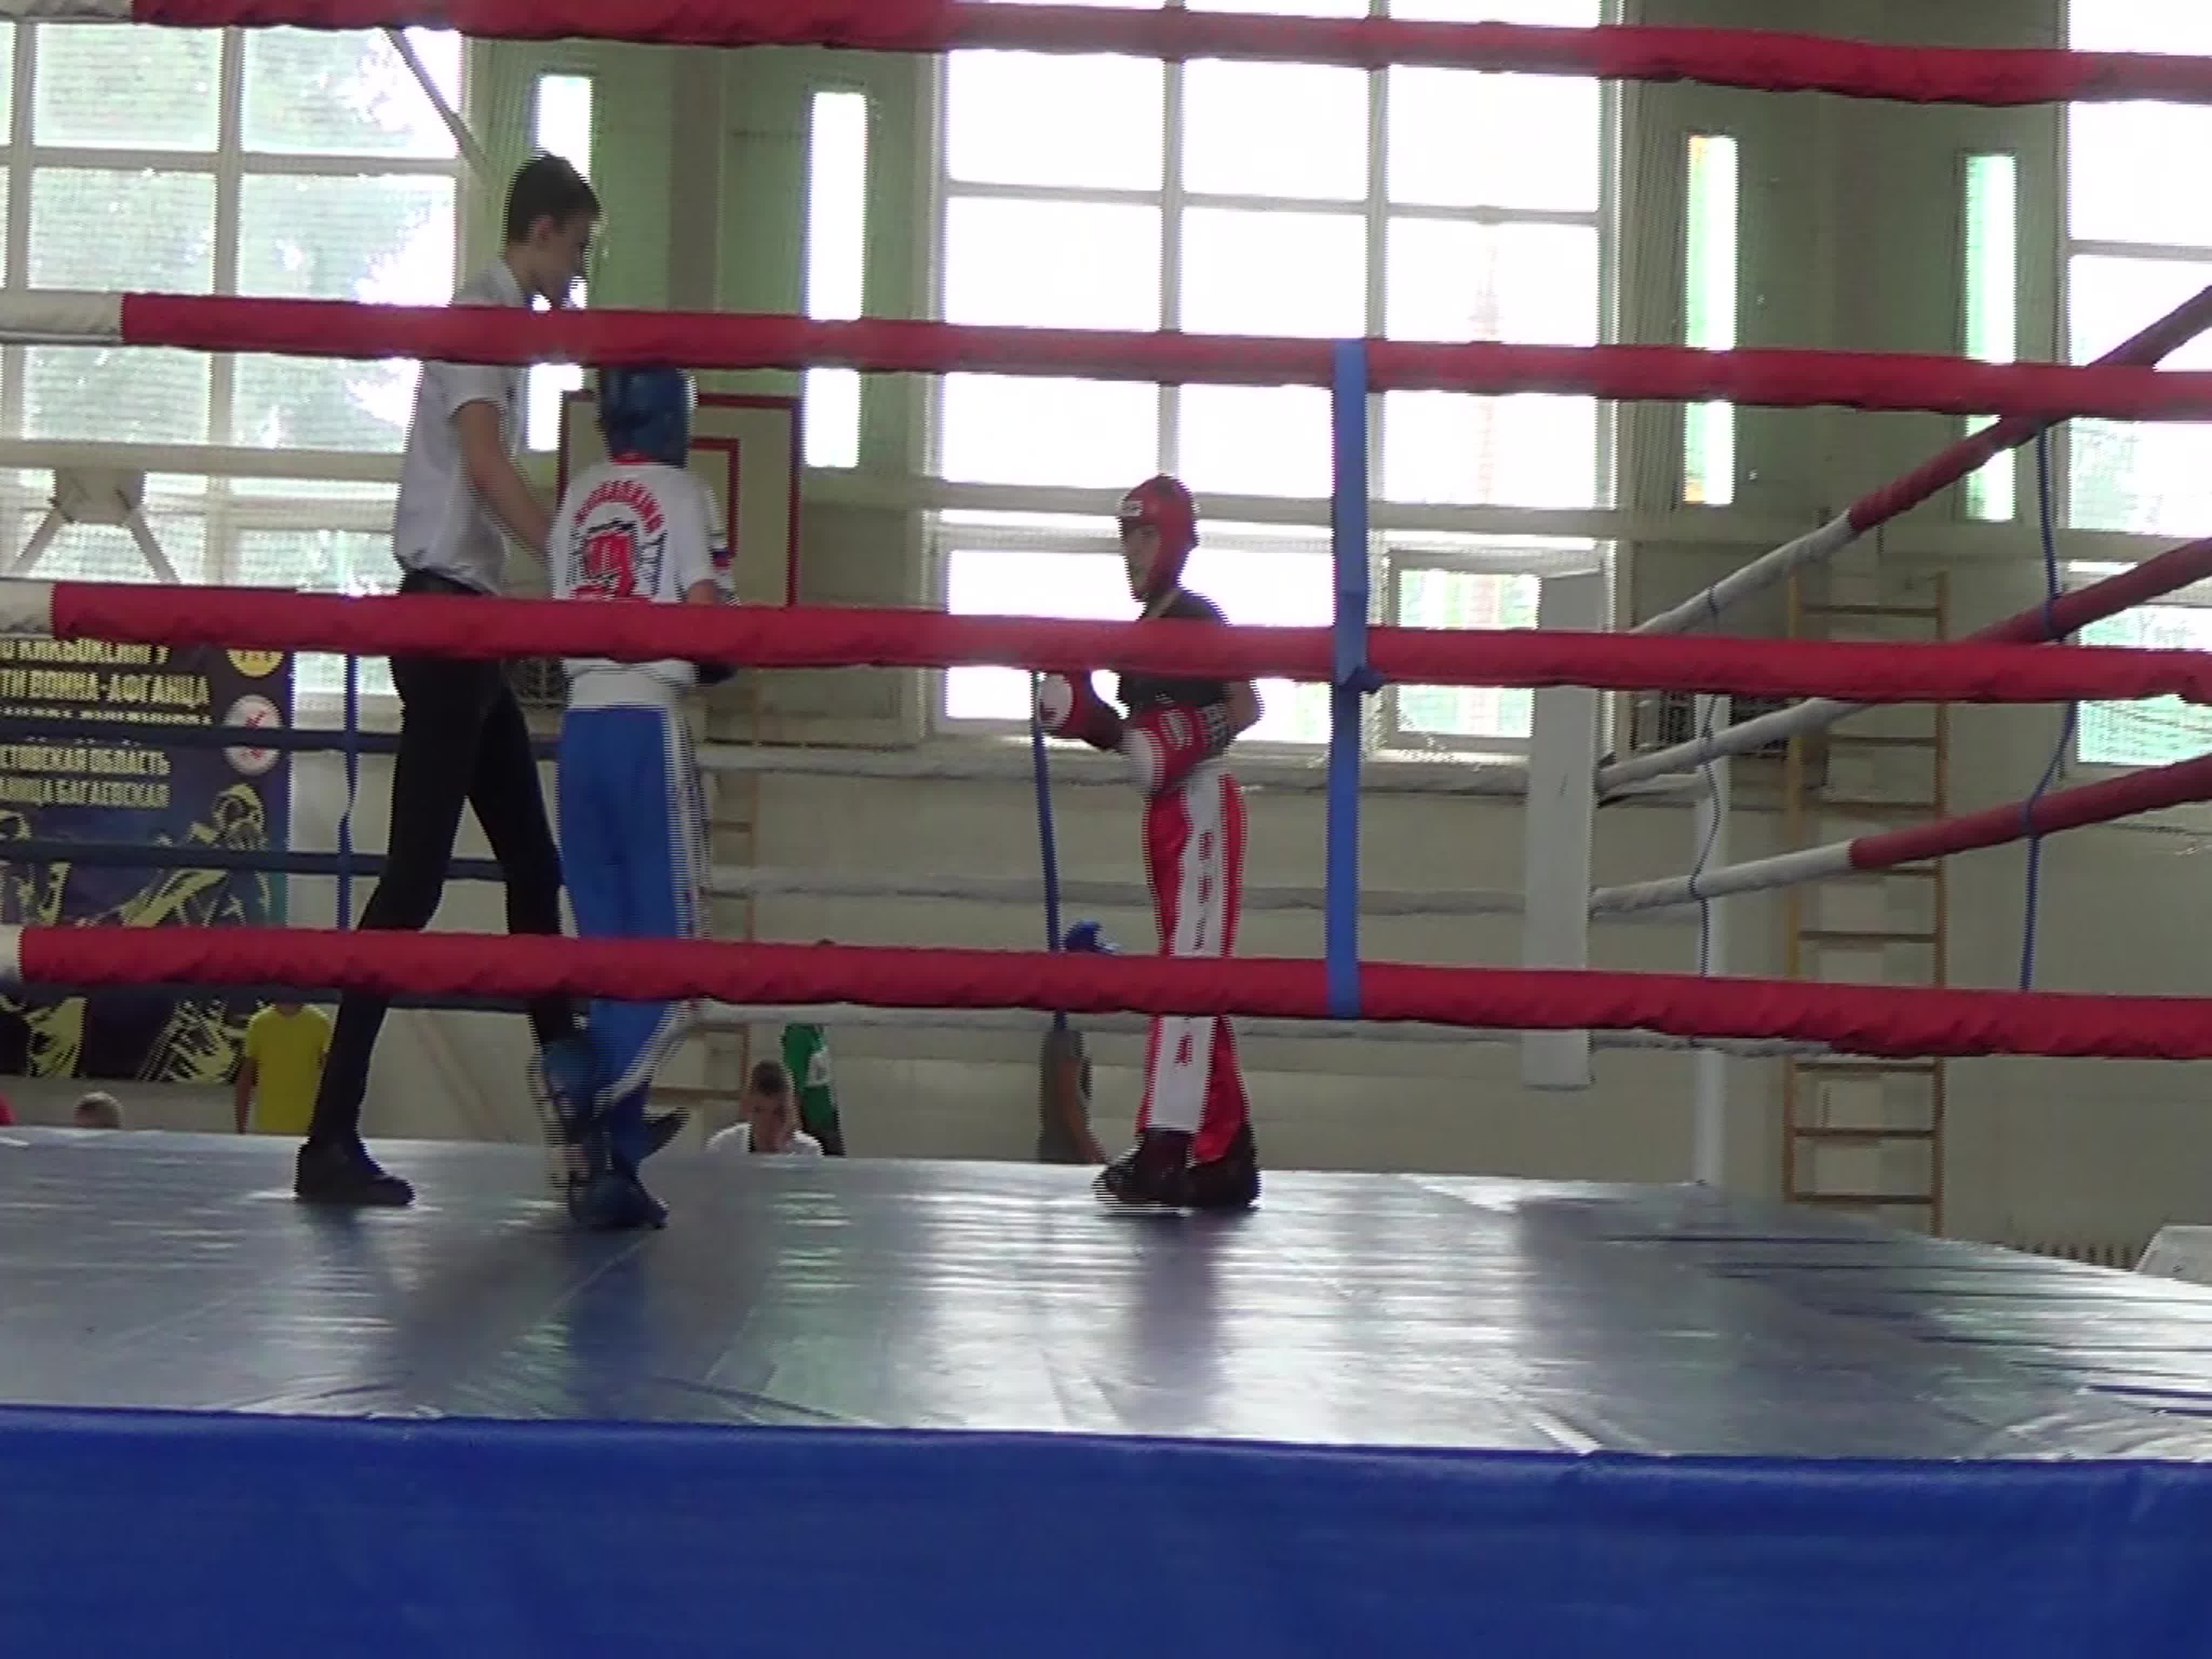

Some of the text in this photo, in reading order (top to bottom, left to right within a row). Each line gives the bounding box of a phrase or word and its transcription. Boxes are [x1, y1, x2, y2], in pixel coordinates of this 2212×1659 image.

[572, 480, 665, 534] KICKBOXING
[0, 669, 211, 708] ТИ ВОИНА-АФГАНЦА
[0, 745, 171, 776] СТОВСКАЯ ОБЛАСТЬ
[57, 780, 171, 808] БАГАЕВСКАЯ
